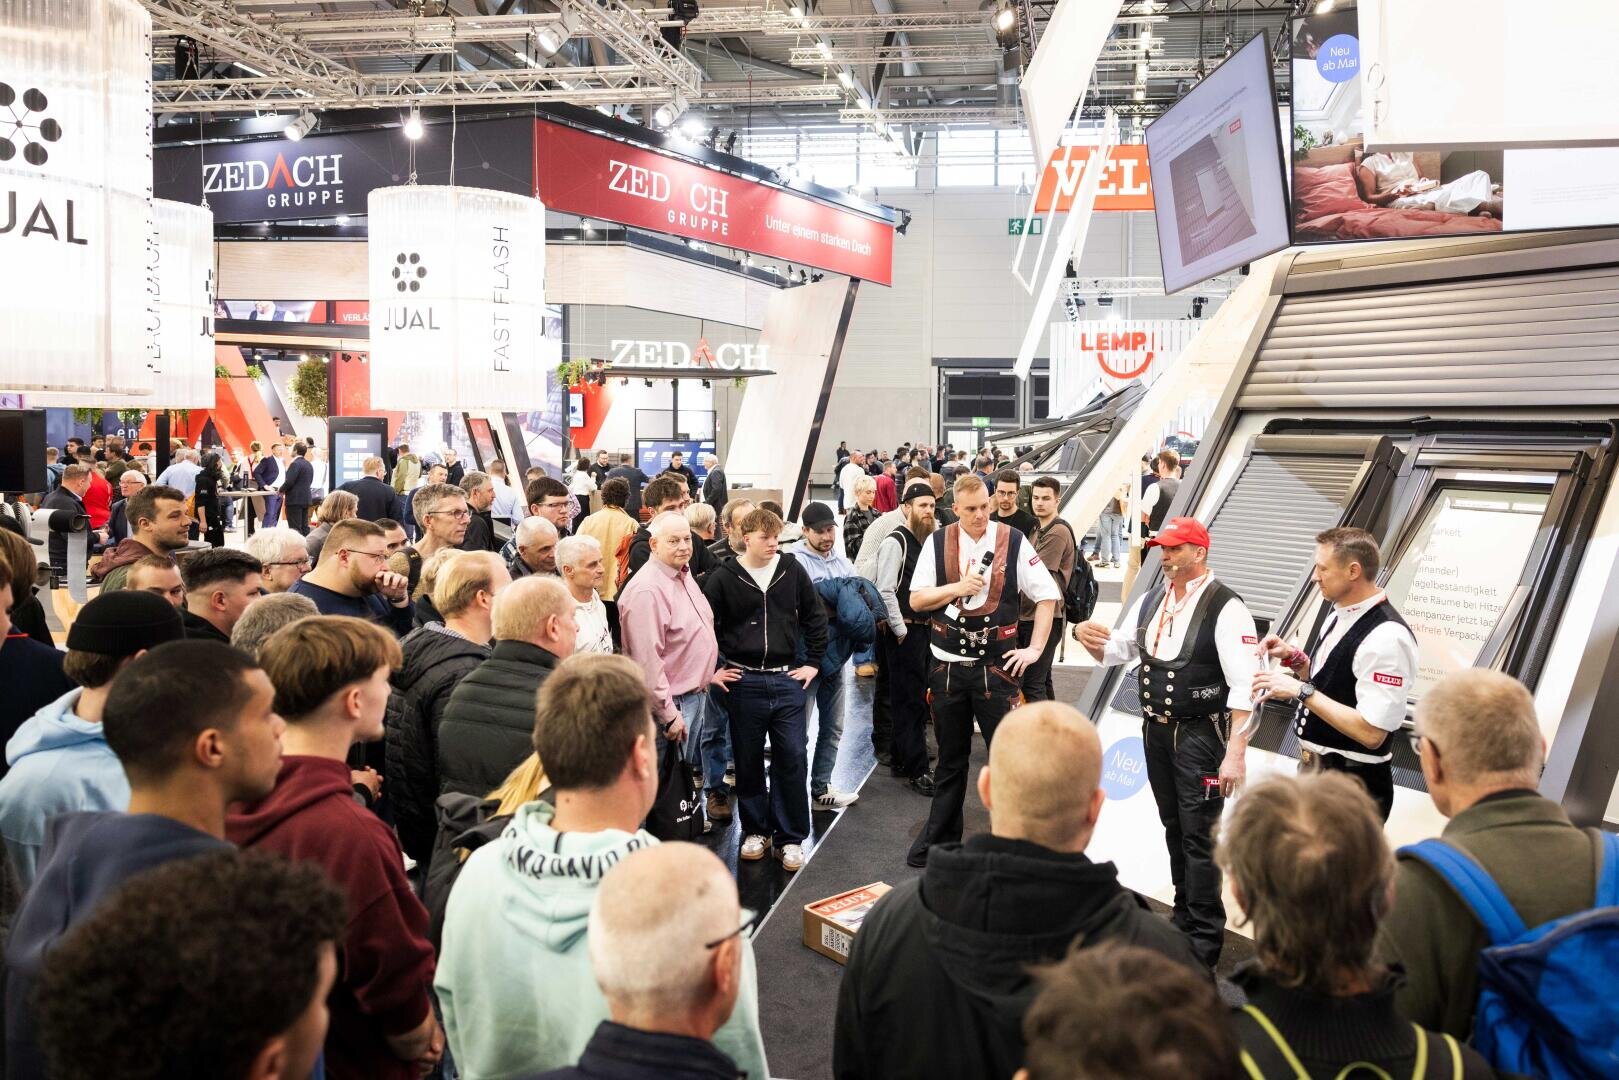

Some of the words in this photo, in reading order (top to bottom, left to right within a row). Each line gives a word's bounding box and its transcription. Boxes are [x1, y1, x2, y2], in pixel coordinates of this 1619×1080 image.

[1330, 46, 1350, 57] Neu
[1322, 60, 1336, 71] ab
[1051, 158, 1153, 196] VEL
[267, 190, 344, 208] GRUPPE
[667, 209, 728, 236] GRUPPE
[766, 214, 792, 234] Unter
[793, 224, 820, 241] einem
[821, 232, 851, 251] starken
[852, 239, 872, 256] Dach
[493, 226, 509, 305] FLASH
[384, 306, 441, 330] JUAL
[493, 311, 510, 373] FAST
[1430, 595, 1461, 607] Räume
[1463, 599, 1478, 609] bei
[1457, 615, 1479, 626] jetzt
[1376, 674, 1402, 685] VELUX
[1111, 749, 1143, 774] Neu
[1104, 769, 1117, 781] ab
[817, 893, 869, 914] VELUX
